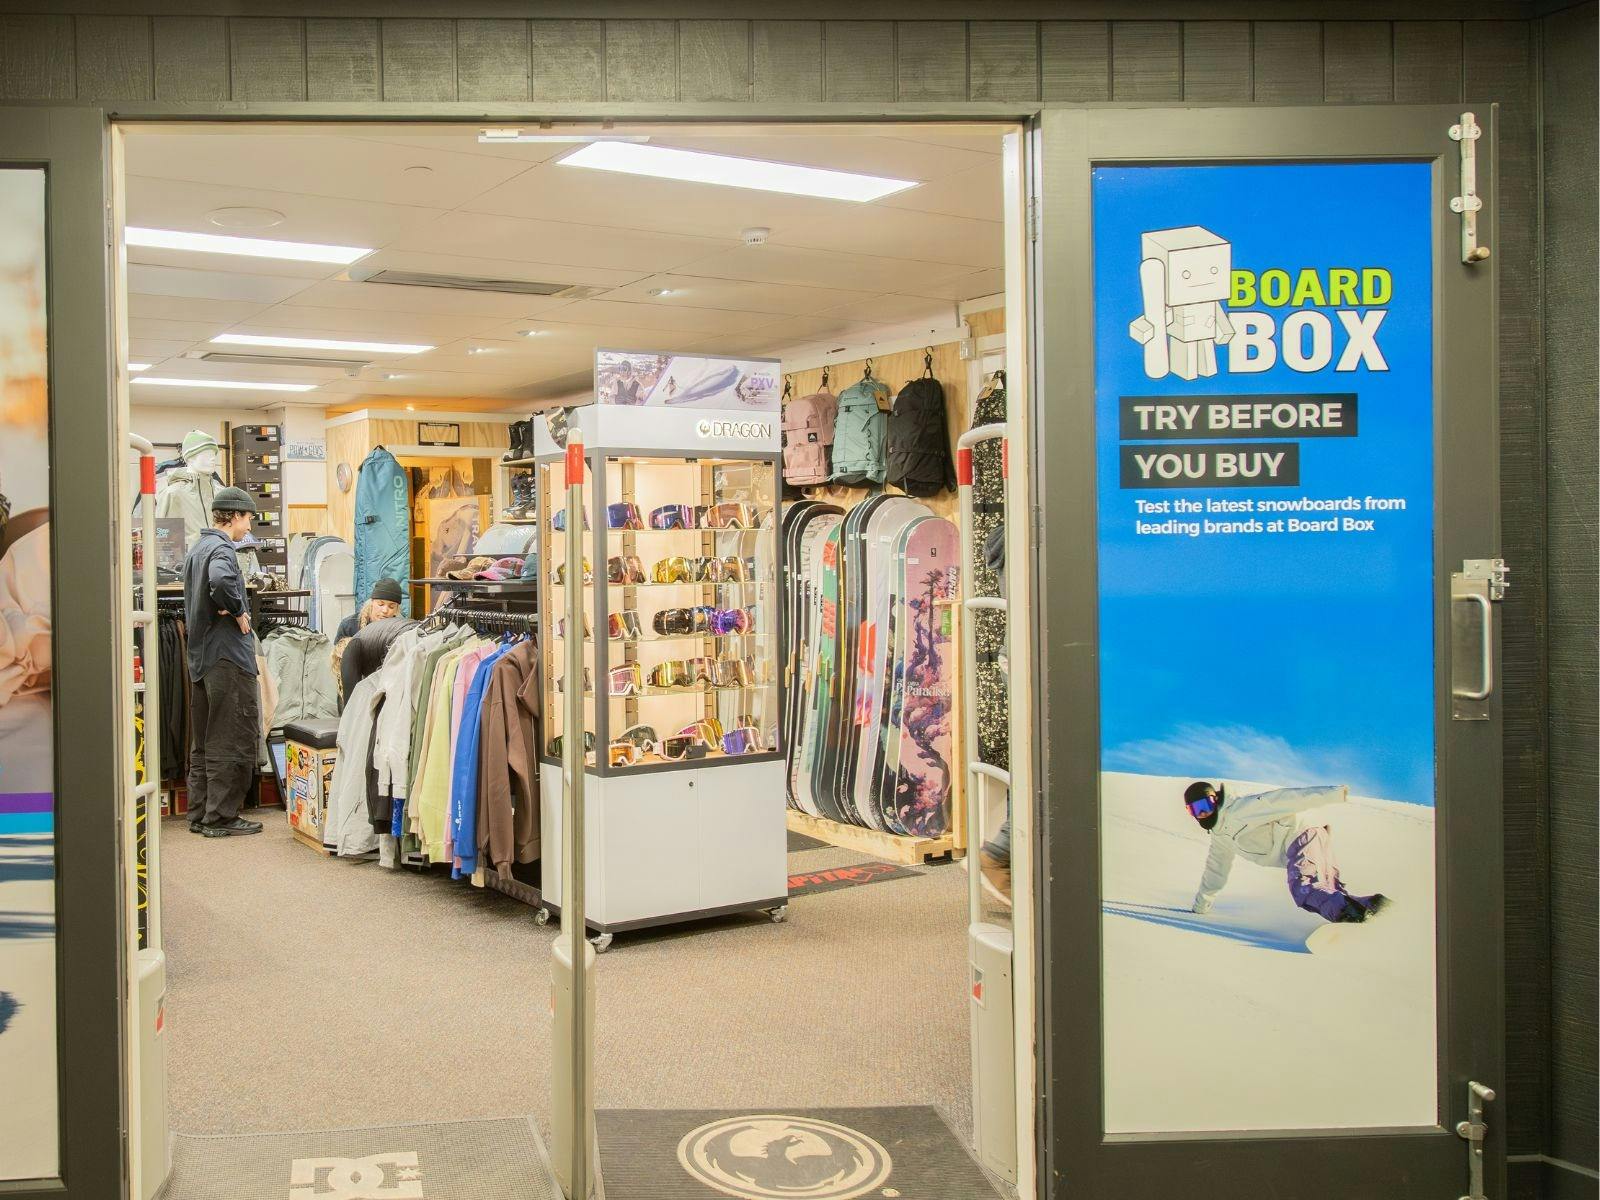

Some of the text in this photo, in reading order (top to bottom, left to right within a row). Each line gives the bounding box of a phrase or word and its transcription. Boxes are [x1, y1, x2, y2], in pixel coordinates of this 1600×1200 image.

[1227, 267, 1393, 307] BOARD
[1227, 309, 1390, 373] BOX
[713, 421, 772, 438] DRAGON
[1133, 402, 1343, 430] TRY BEFORE
[1134, 452, 1286, 479] YOU BUY
[393, 475, 405, 528] NITRO
[1135, 496, 1407, 514] Test the latest snowboards from
[1136, 517, 1375, 537] leading brands at Board Box
